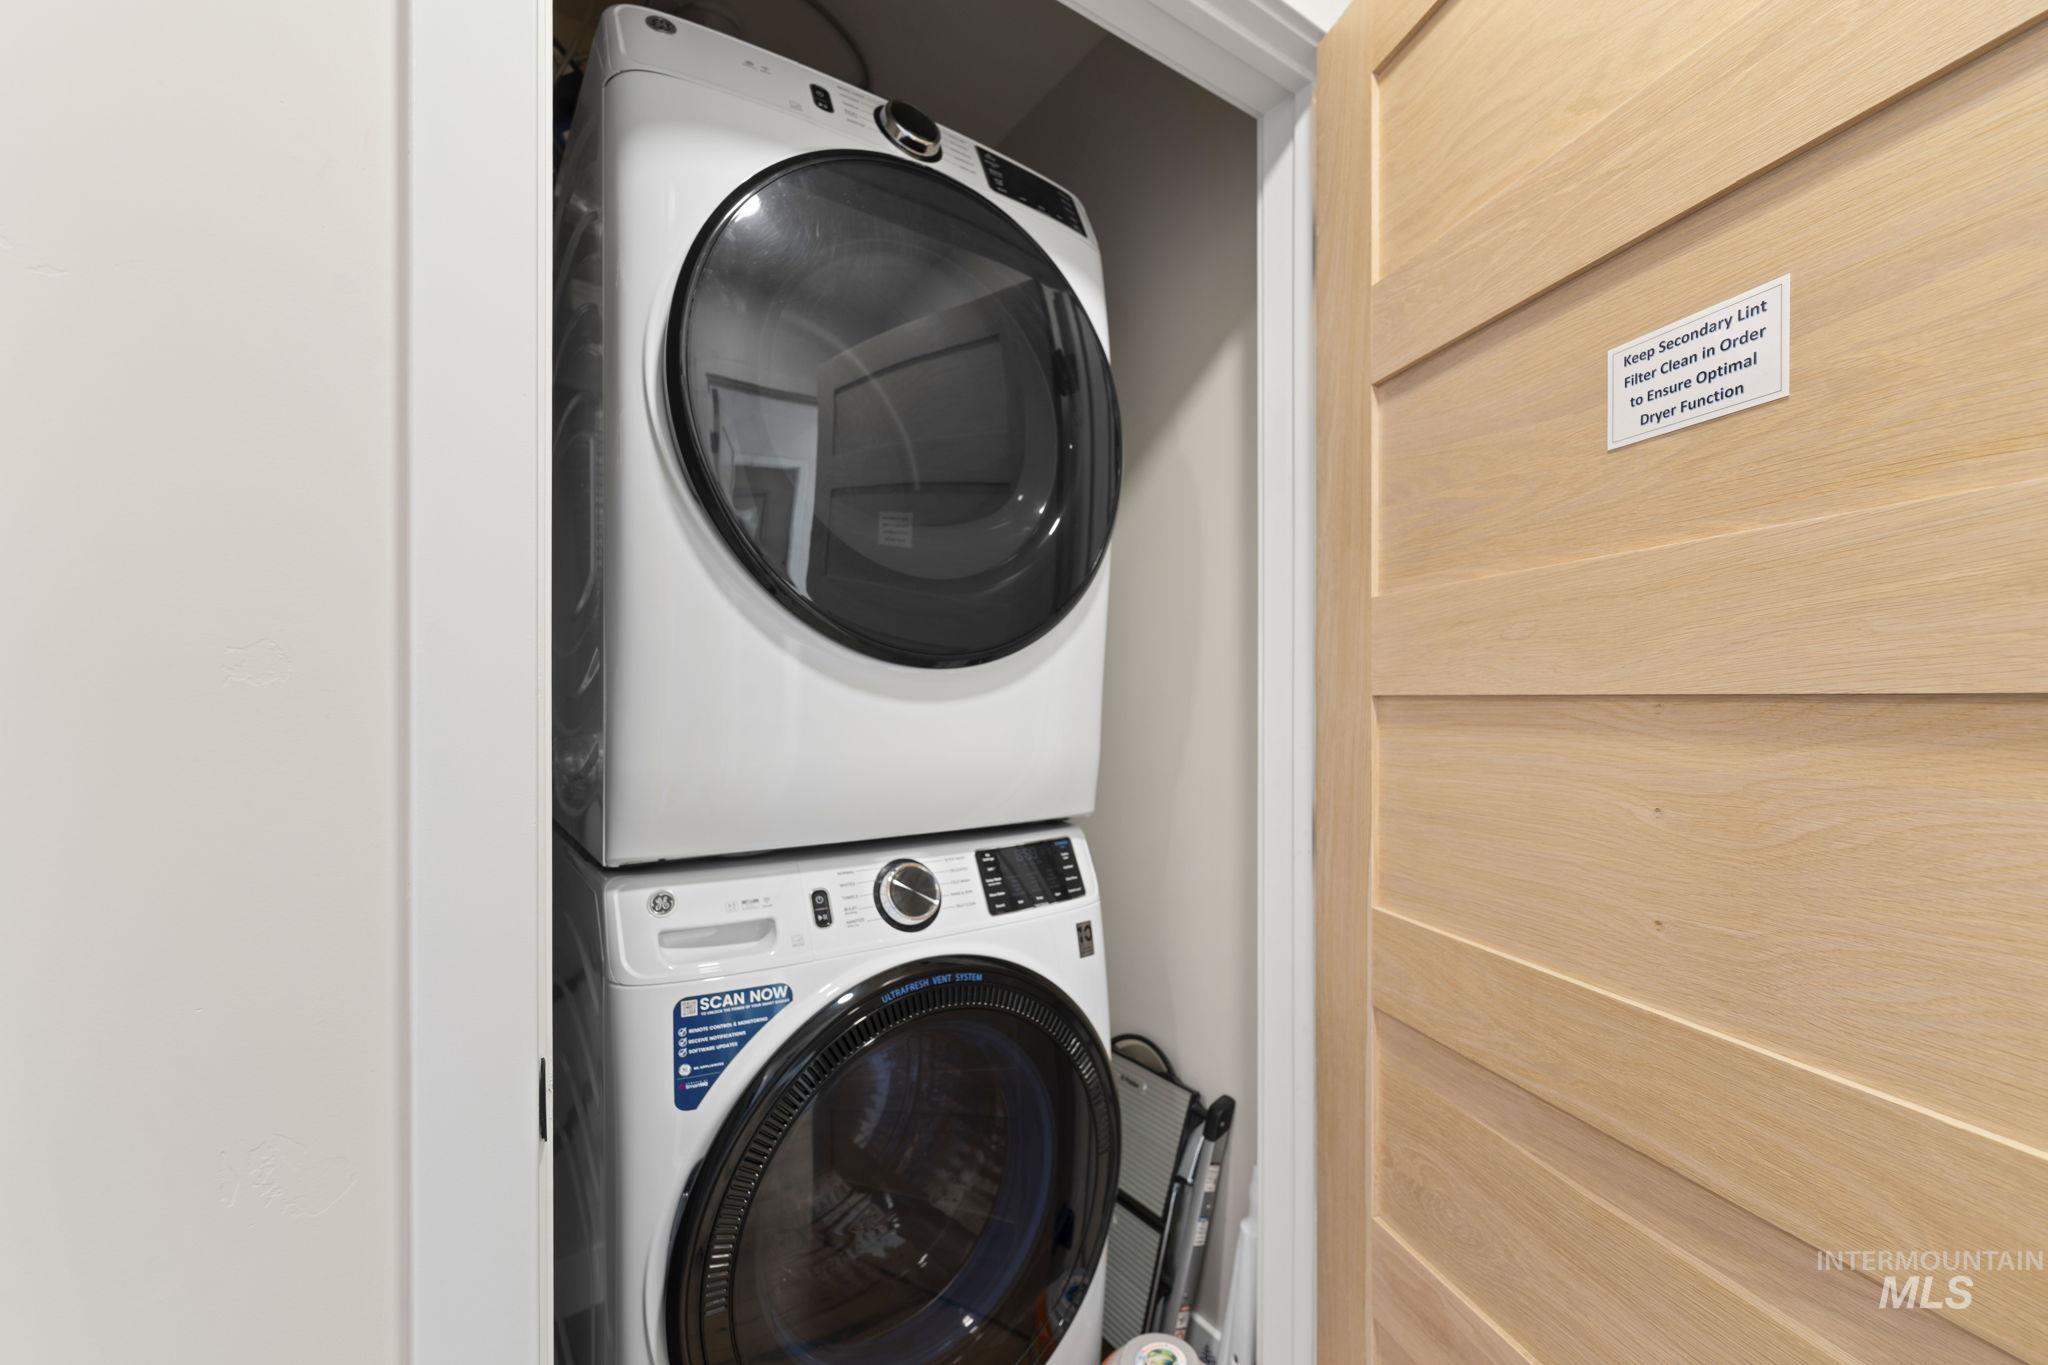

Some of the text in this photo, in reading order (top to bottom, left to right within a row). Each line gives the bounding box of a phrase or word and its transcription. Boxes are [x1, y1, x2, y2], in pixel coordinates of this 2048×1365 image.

[1623, 300, 1767, 367] Keep Secondary Lint
[1624, 326, 1766, 388] Filter Clean in Order
[1630, 351, 1757, 408] to Ensure Optimal
[1640, 384, 1744, 426] Dryer Function
[700, 985, 788, 1011] SCAN NOW
[881, 972, 983, 1004] ULTRAFRESH VENT SYSTEM
[688, 1026, 709, 1034] REMOTE
[709, 1022, 733, 1031] CONTROL
[737, 1016, 769, 1026] MONITORING
[688, 1030, 747, 1045] RECEIVE NOTIFICATIONS
[688, 1041, 738, 1055] SOFTWARE UPDATES
